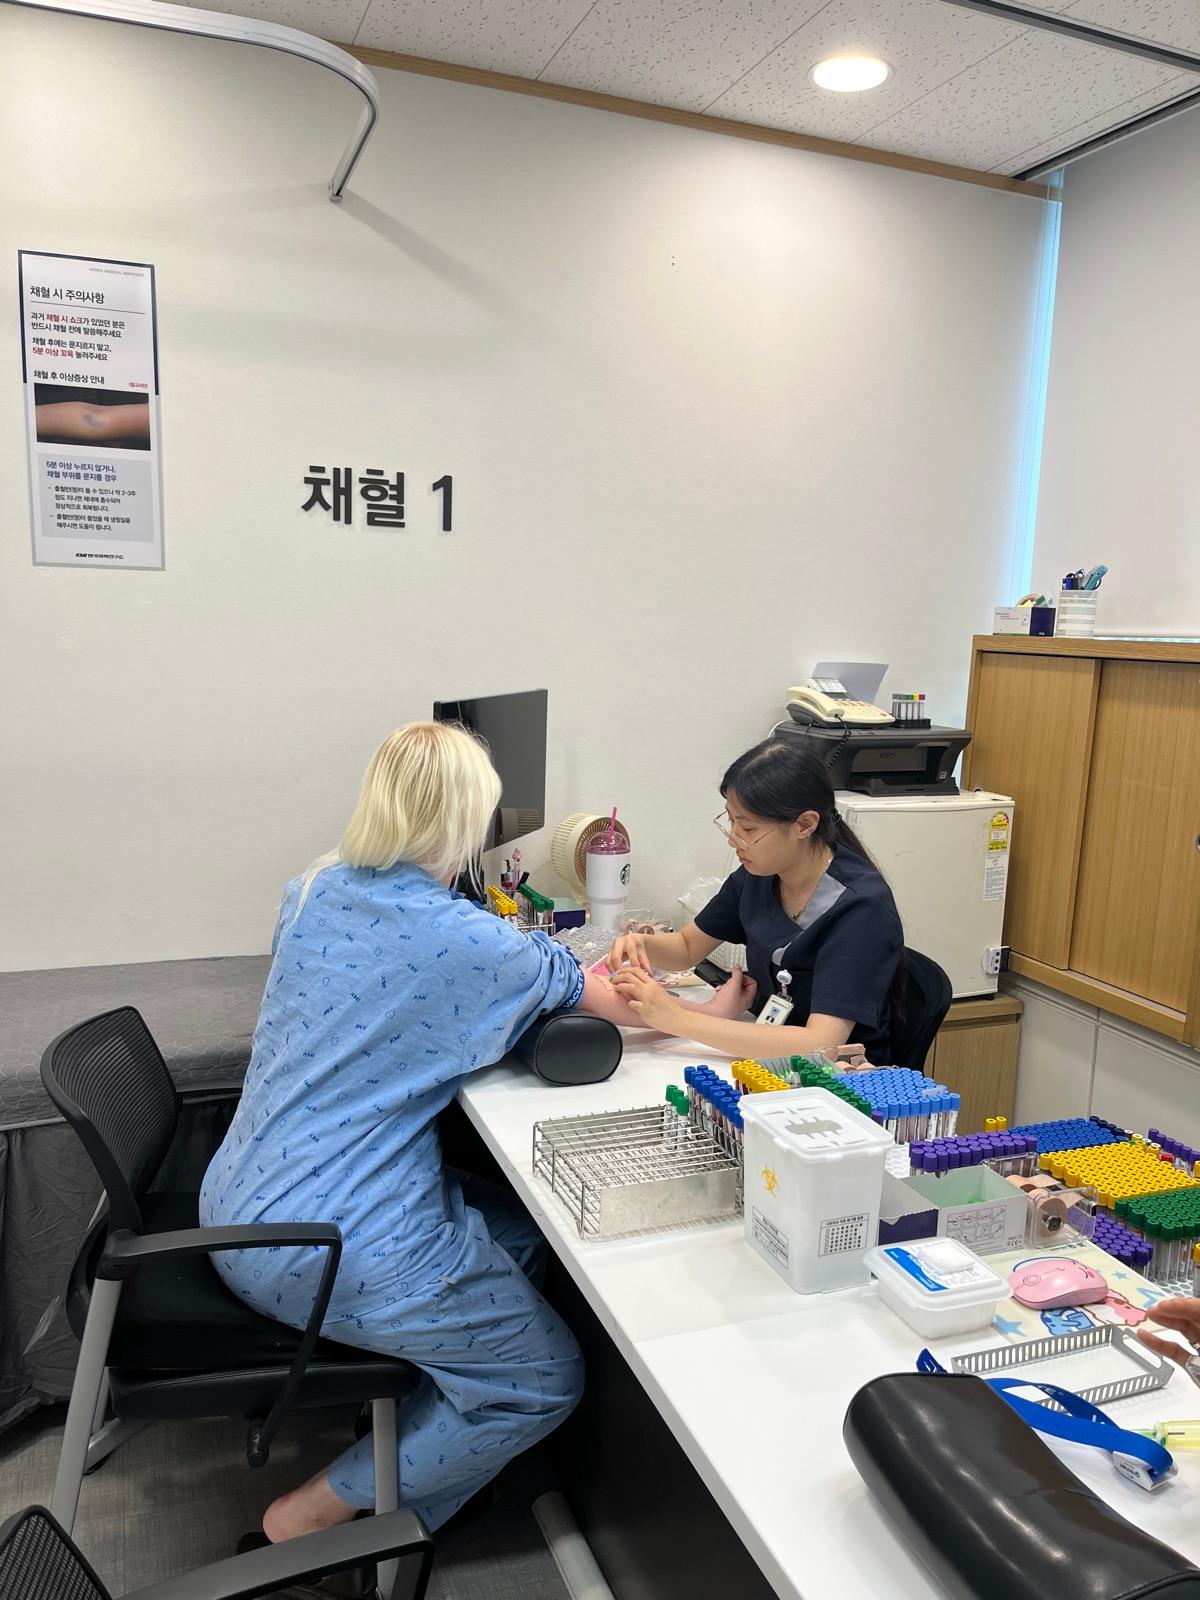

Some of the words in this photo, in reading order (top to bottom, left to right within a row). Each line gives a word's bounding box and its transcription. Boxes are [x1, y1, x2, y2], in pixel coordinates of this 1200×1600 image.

[30, 286, 50, 298] 채혈
[52, 288, 62, 300] 시
[66, 290, 104, 304] 주의사항
[31, 312, 44, 320] 과거
[46, 314, 60, 322] 채혈
[61, 315, 68, 323] 시
[70, 316, 89, 325] 쇼크가
[91, 318, 110, 327] 있었던
[112, 320, 124, 329] 분은
[32, 322, 51, 331] 반드시
[53, 324, 66, 332] 채혈
[68, 326, 82, 334] 전에
[83, 327, 122, 338] 말씀해주세요
[32, 337, 46, 346] 채혈
[48, 338, 67, 348] 후에는
[69, 340, 96, 352] 문지르지
[32, 347, 44, 355] 5분
[46, 348, 58, 357] 이상
[76, 351, 108, 360] 눌러주세요
[34, 370, 48, 379] 채혈
[50, 372, 58, 380] 후
[60, 372, 88, 383] 이상증상
[90, 376, 104, 384] 안내
[46, 461, 57, 469] 5분
[58, 462, 72, 470] 이상
[74, 463, 94, 472] 누르지
[47, 470, 60, 478] 채혈
[62, 471, 82, 480] 부위를
[83, 472, 102, 482] 문지를
[104, 474, 118, 482] 경우
[301, 465, 405, 528] 채혈
[432, 475, 452, 532] 1
